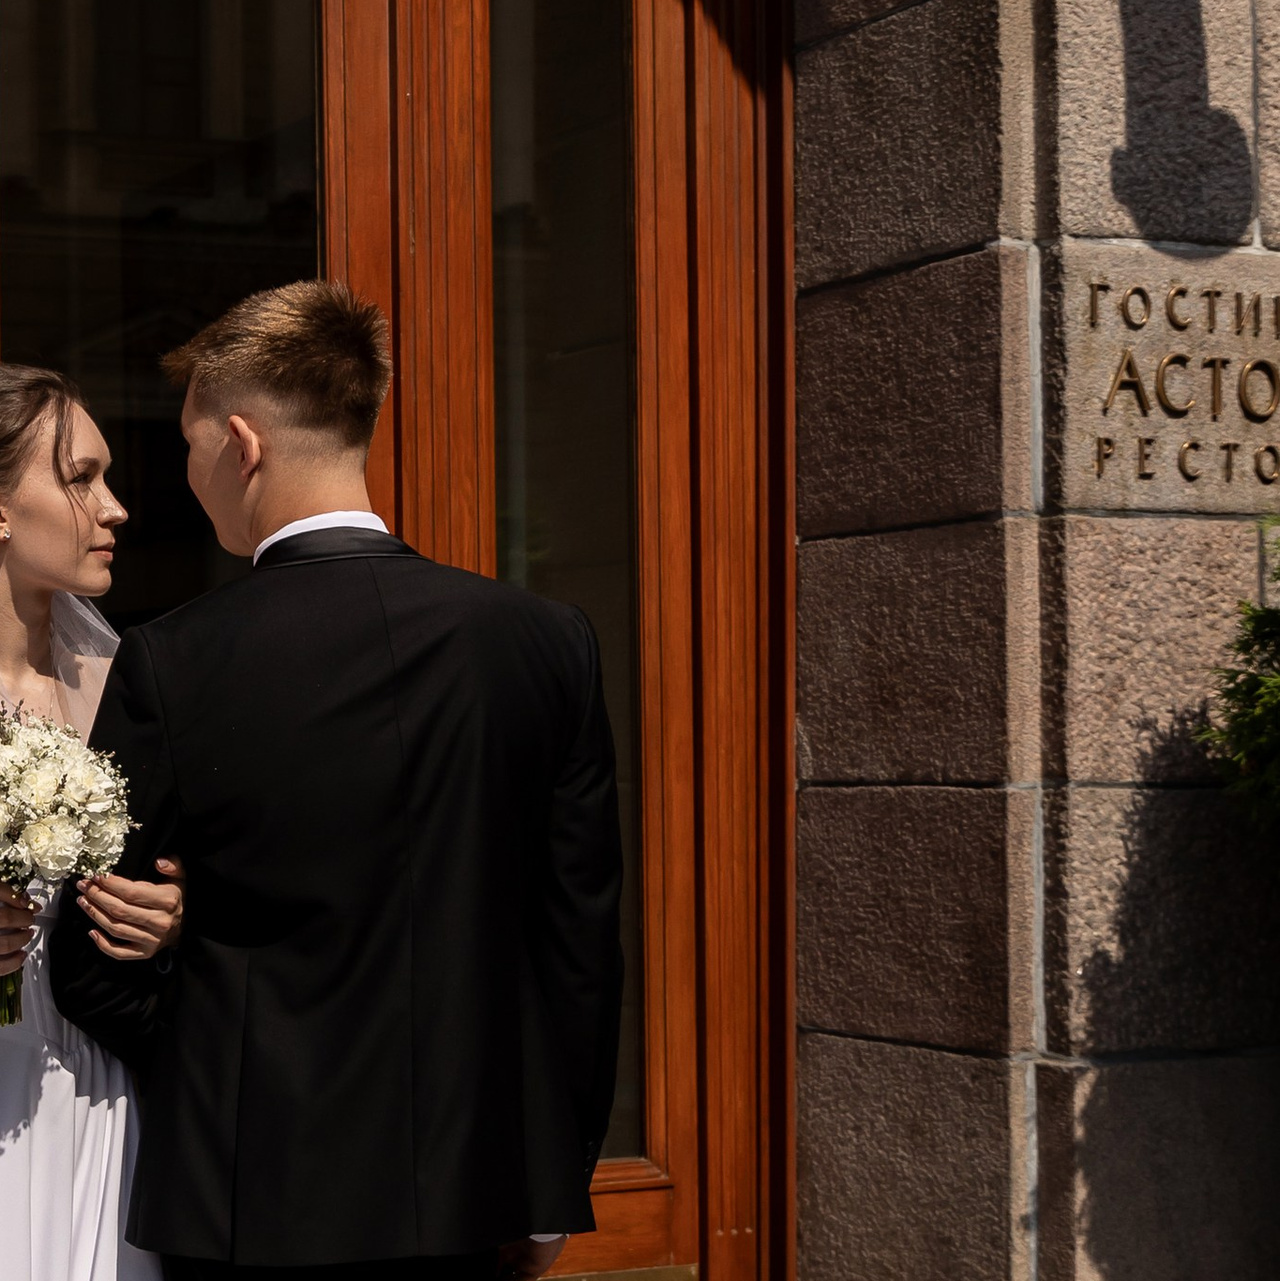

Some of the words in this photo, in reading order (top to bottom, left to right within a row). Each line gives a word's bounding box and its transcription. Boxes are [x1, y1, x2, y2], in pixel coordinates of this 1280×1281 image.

[1088, 282, 1280, 340] ГОСТИ
[1102, 348, 1280, 421] АСТО
[1094, 437, 1280, 484] РЕСТО
